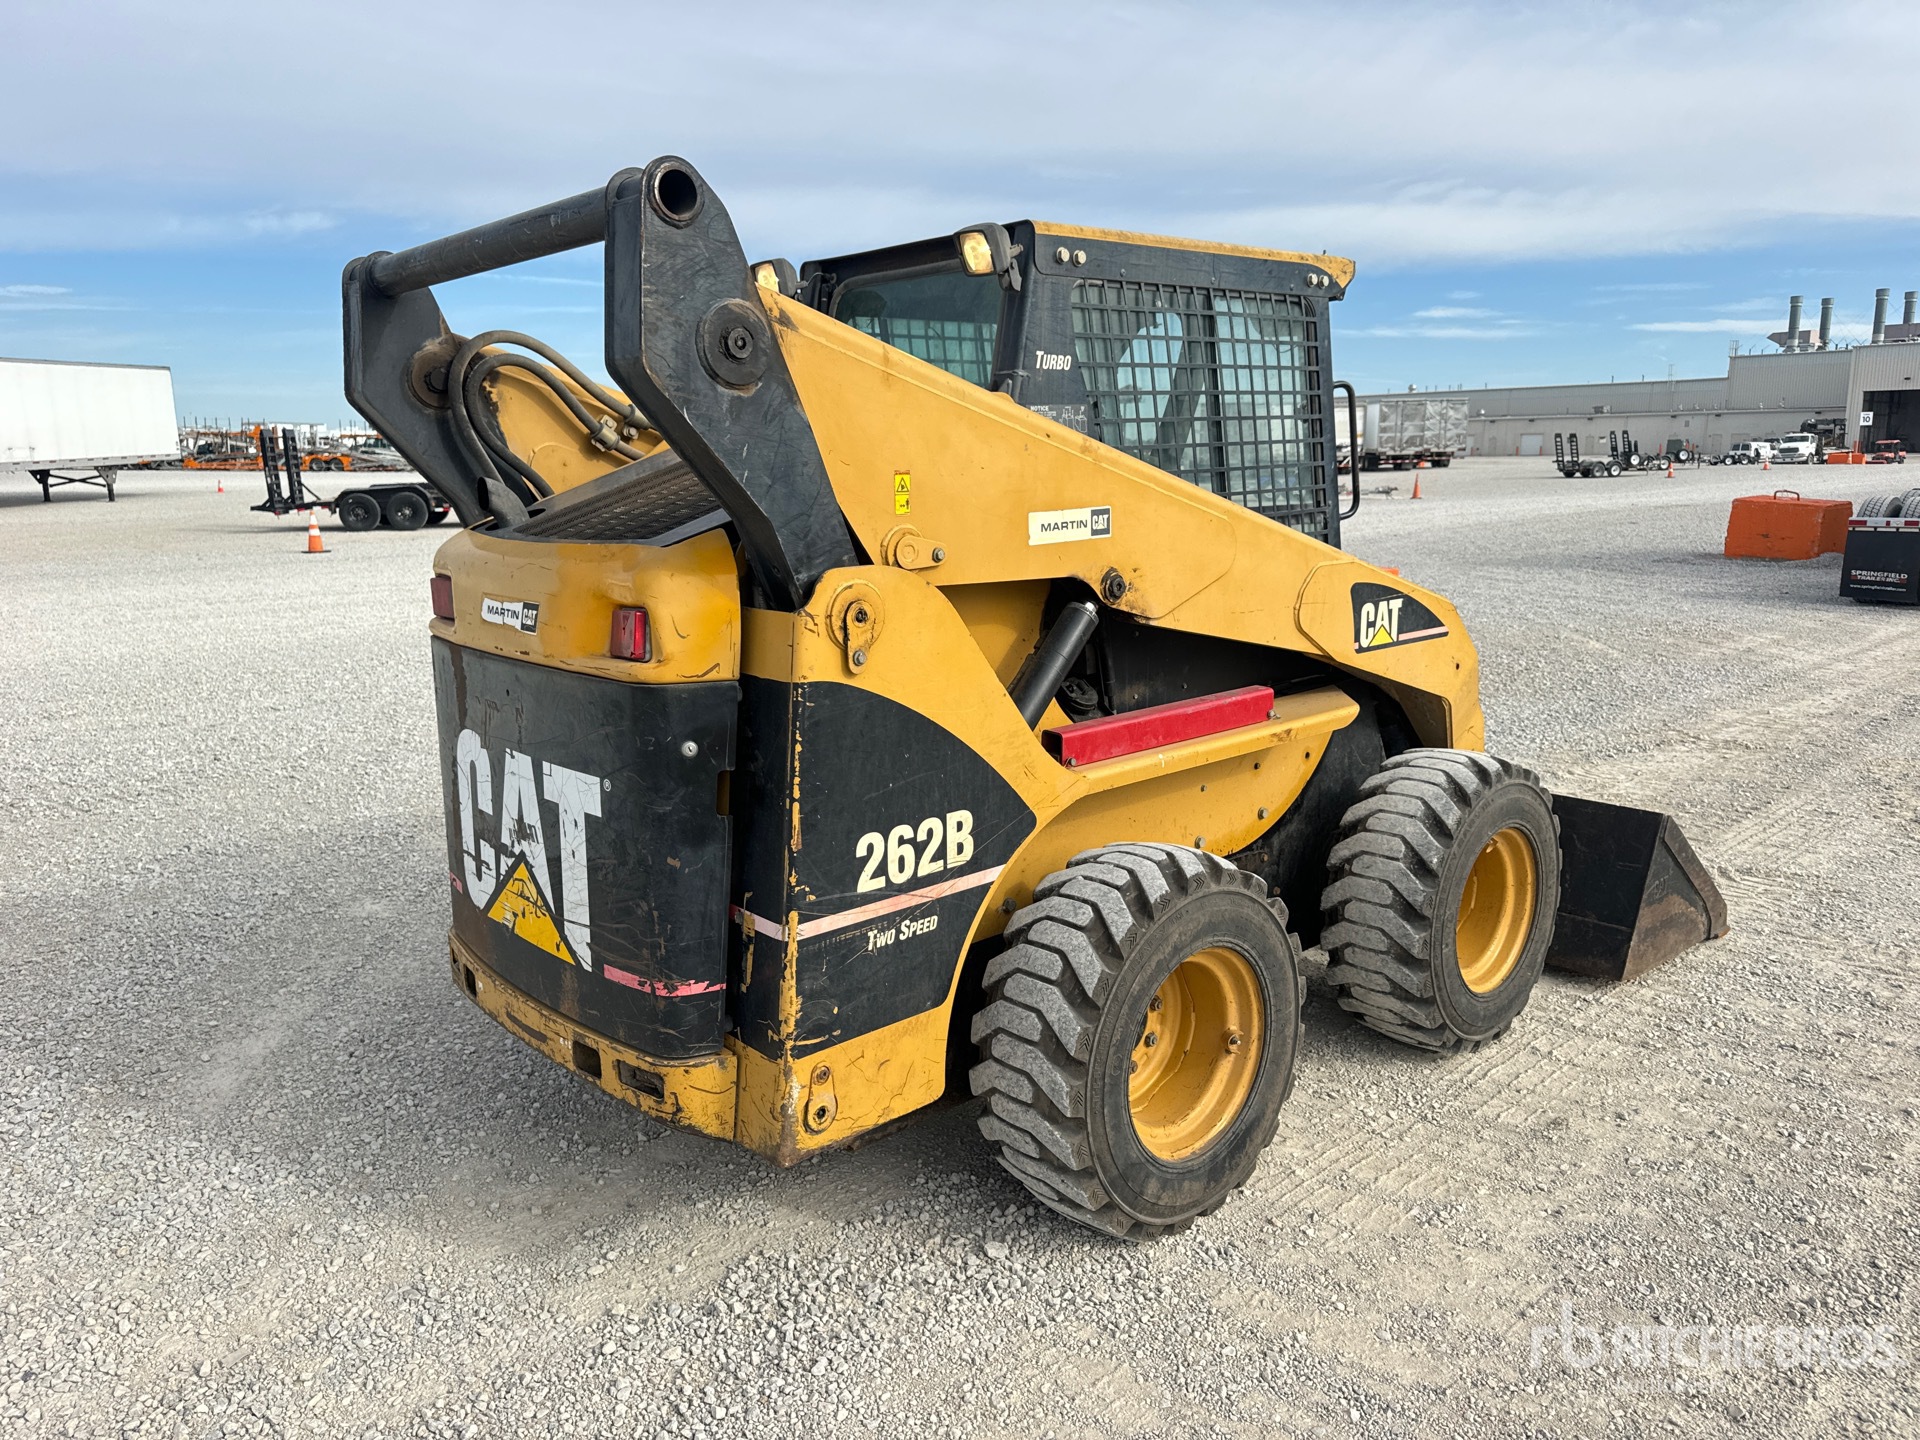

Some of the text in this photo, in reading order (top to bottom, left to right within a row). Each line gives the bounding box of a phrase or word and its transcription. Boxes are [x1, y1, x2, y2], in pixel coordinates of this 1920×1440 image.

[1035, 350, 1072, 371] TURBO
[1041, 514, 1109, 533] MARTIN CAT
[1850, 569, 1908, 579] SPRINGFIELD
[487, 605, 537, 625] MARTIN CAT
[1360, 598, 1404, 648] CAT
[855, 809, 975, 893] 262B
[867, 928, 896, 951] TWO
[899, 915, 938, 941] SPEED
